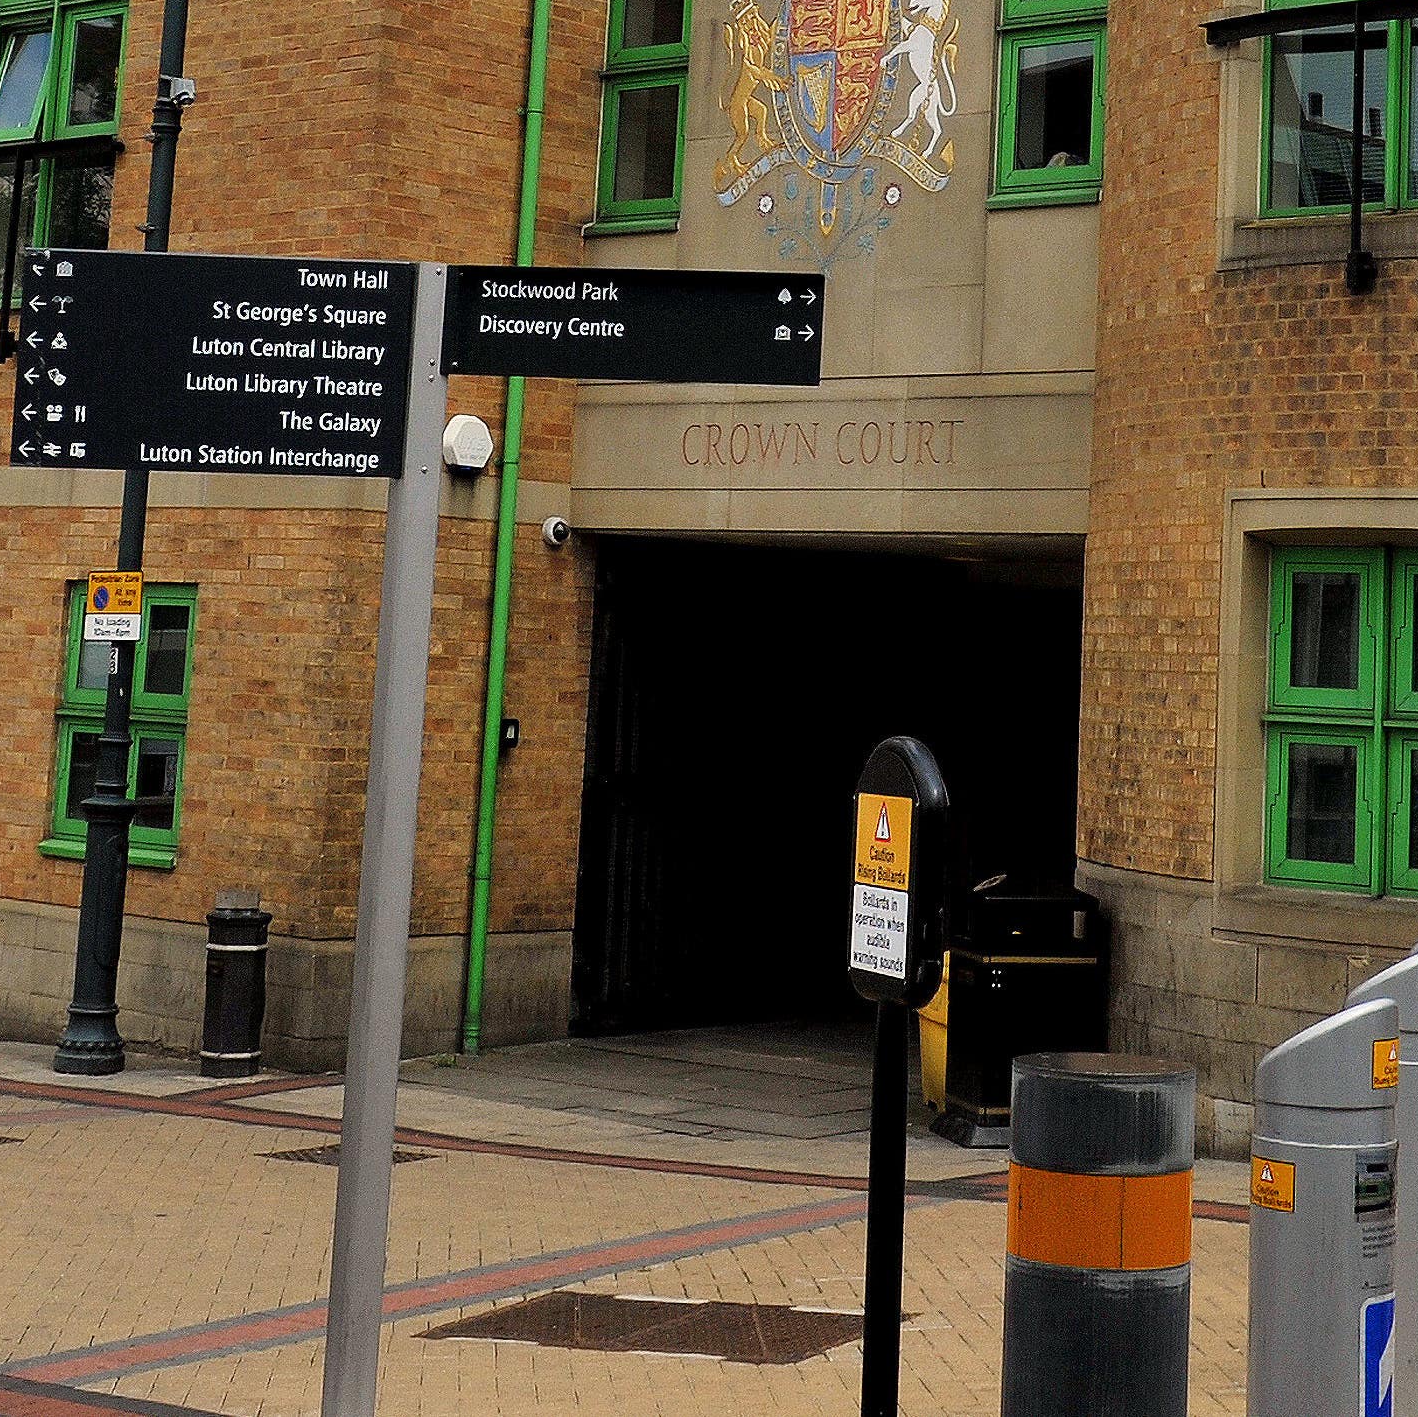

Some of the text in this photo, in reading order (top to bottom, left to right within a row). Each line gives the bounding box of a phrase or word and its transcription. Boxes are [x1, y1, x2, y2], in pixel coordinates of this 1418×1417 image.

[298, 269, 389, 290] Town Hall
[482, 280, 619, 301] Stockwood Park
[213, 301, 387, 328] St George's Square
[479, 315, 625, 340] Discovery Centre
[192, 336, 385, 366] Luton Central Library
[186, 372, 383, 399] Luton Library Theatre
[280, 411, 382, 438] The Galaxy
[683, 420, 964, 466] CROWN COURT
[140, 443, 379, 472] Luton Station Interchange
[868, 845, 896, 864] Caution
[857, 862, 906, 884] Rising Bollards
[862, 891, 898, 912] Bollards in
[855, 912, 905, 932] operation when
[866, 933, 891, 950] audible
[853, 949, 904, 973] warning sounds
